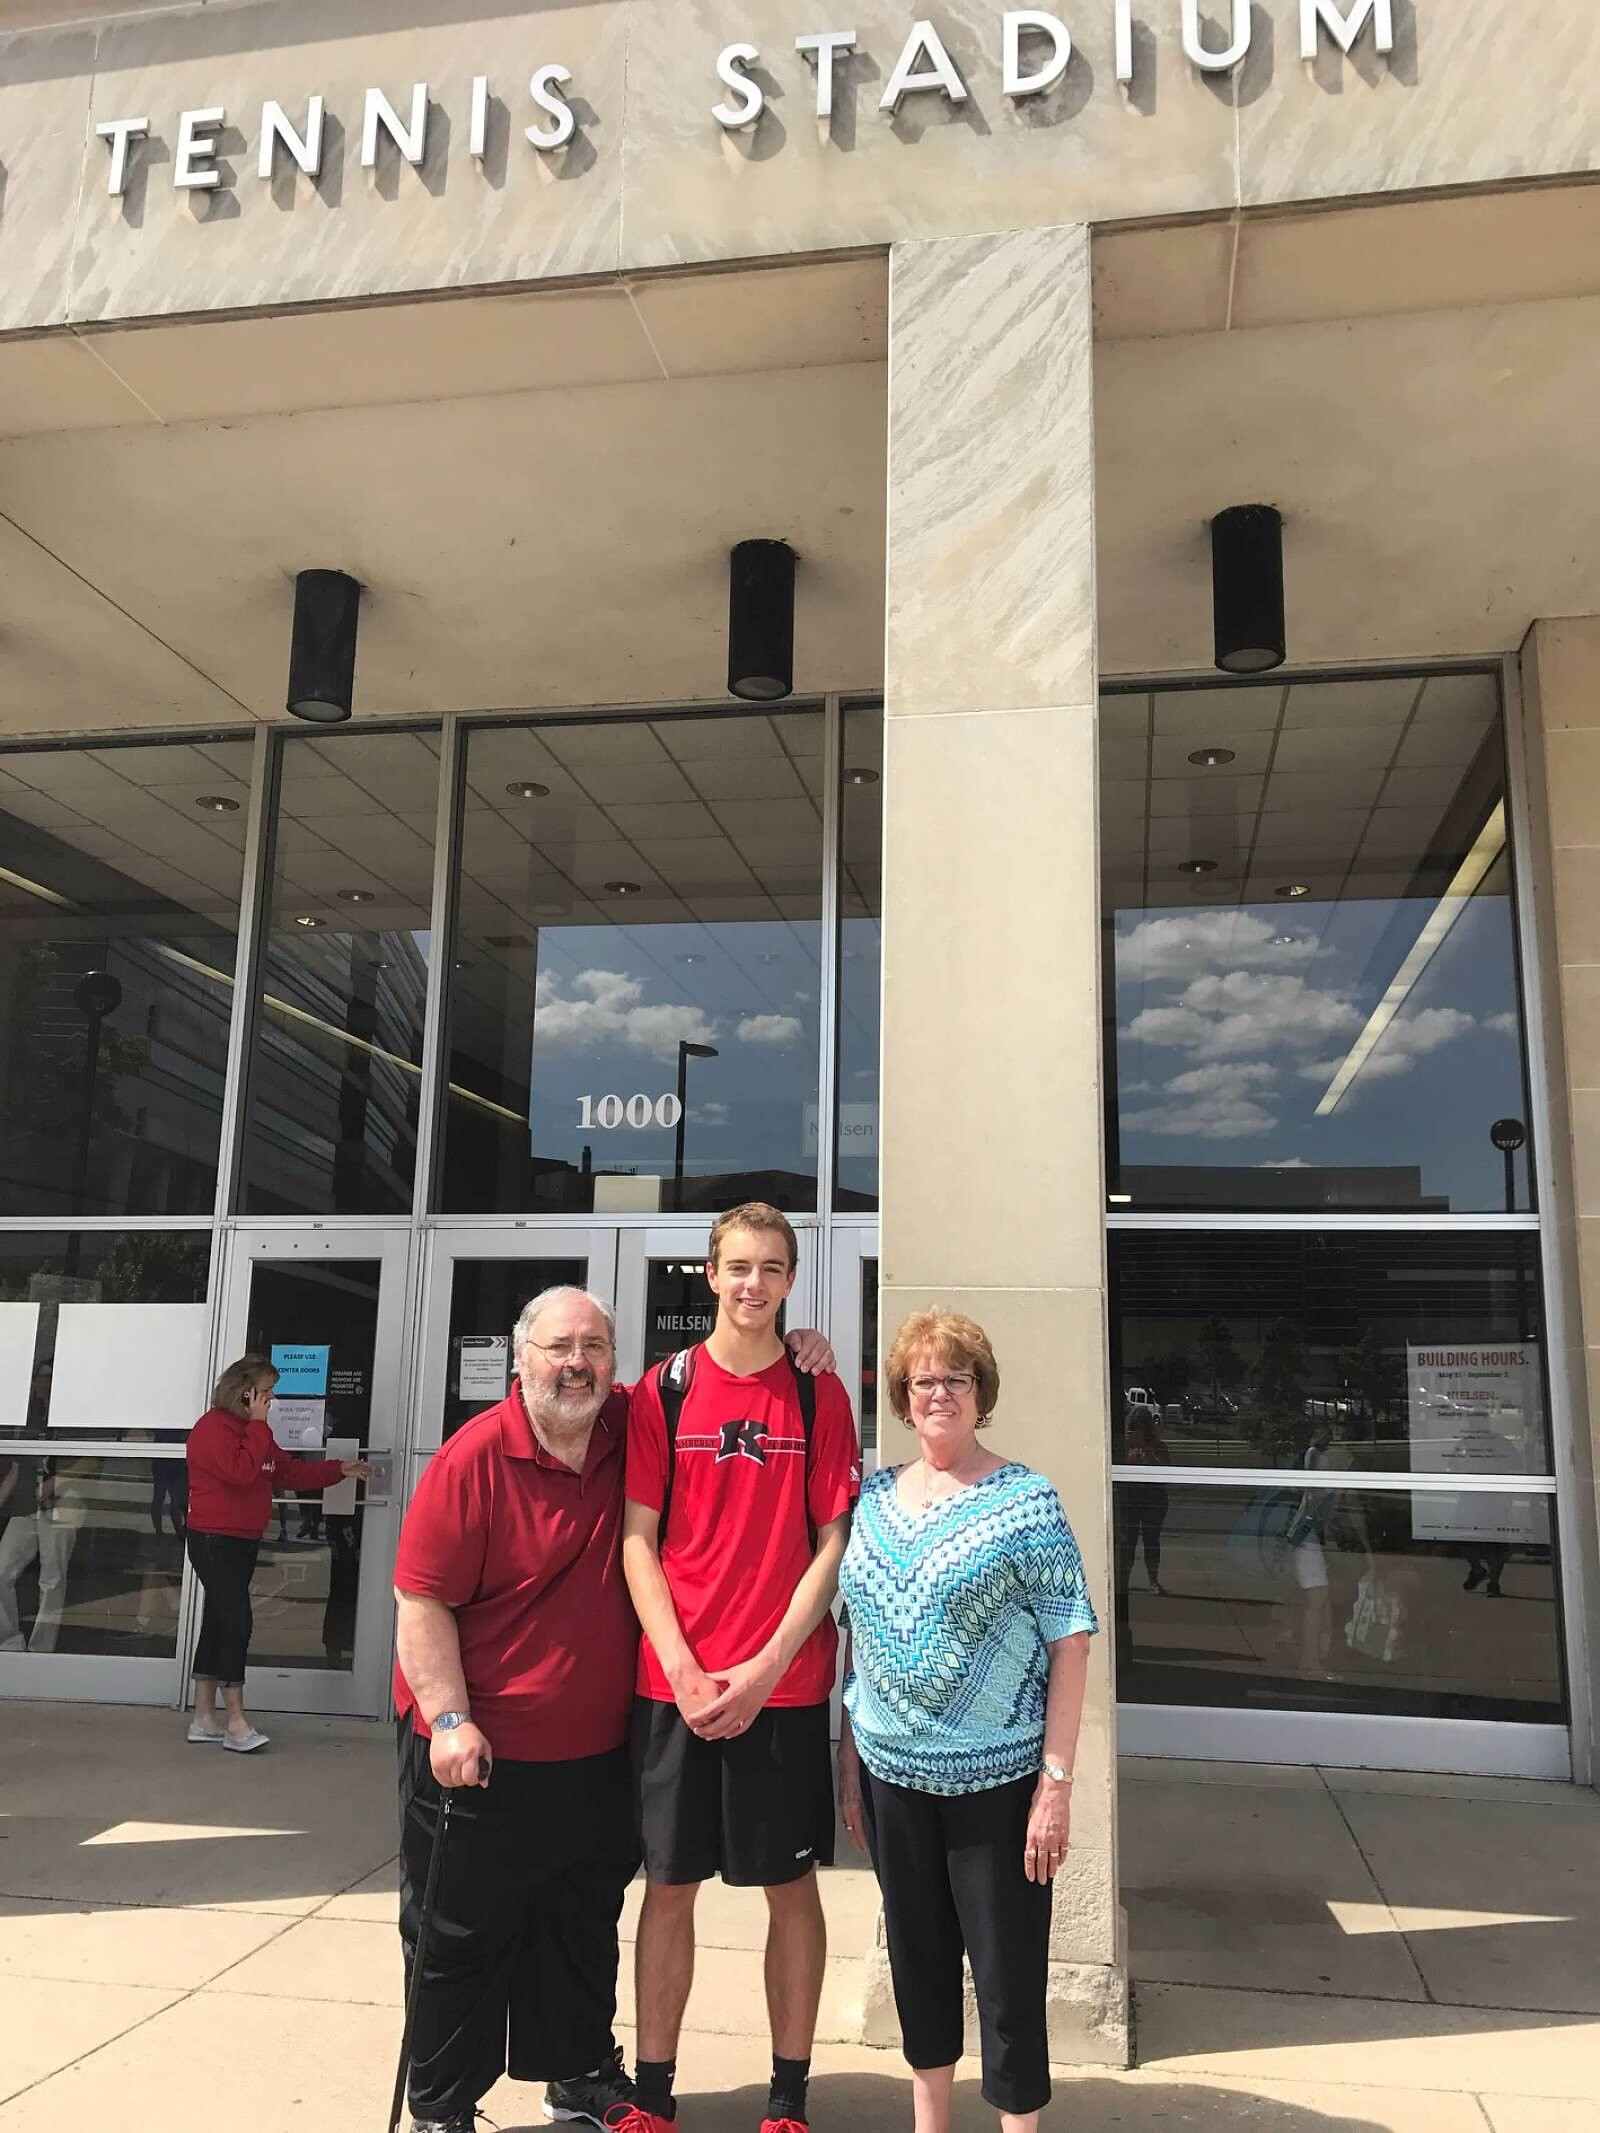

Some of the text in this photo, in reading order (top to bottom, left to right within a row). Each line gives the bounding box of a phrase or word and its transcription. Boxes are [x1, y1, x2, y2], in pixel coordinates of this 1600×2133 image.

[95, 0, 1395, 198] TENNIS STADIUM
[575, 1092, 682, 1129] 1000
[657, 1315, 712, 1331] NIELSEN
[1417, 1350, 1530, 1367] BUILDING HOURS.
[714, 1419, 769, 1466] K
